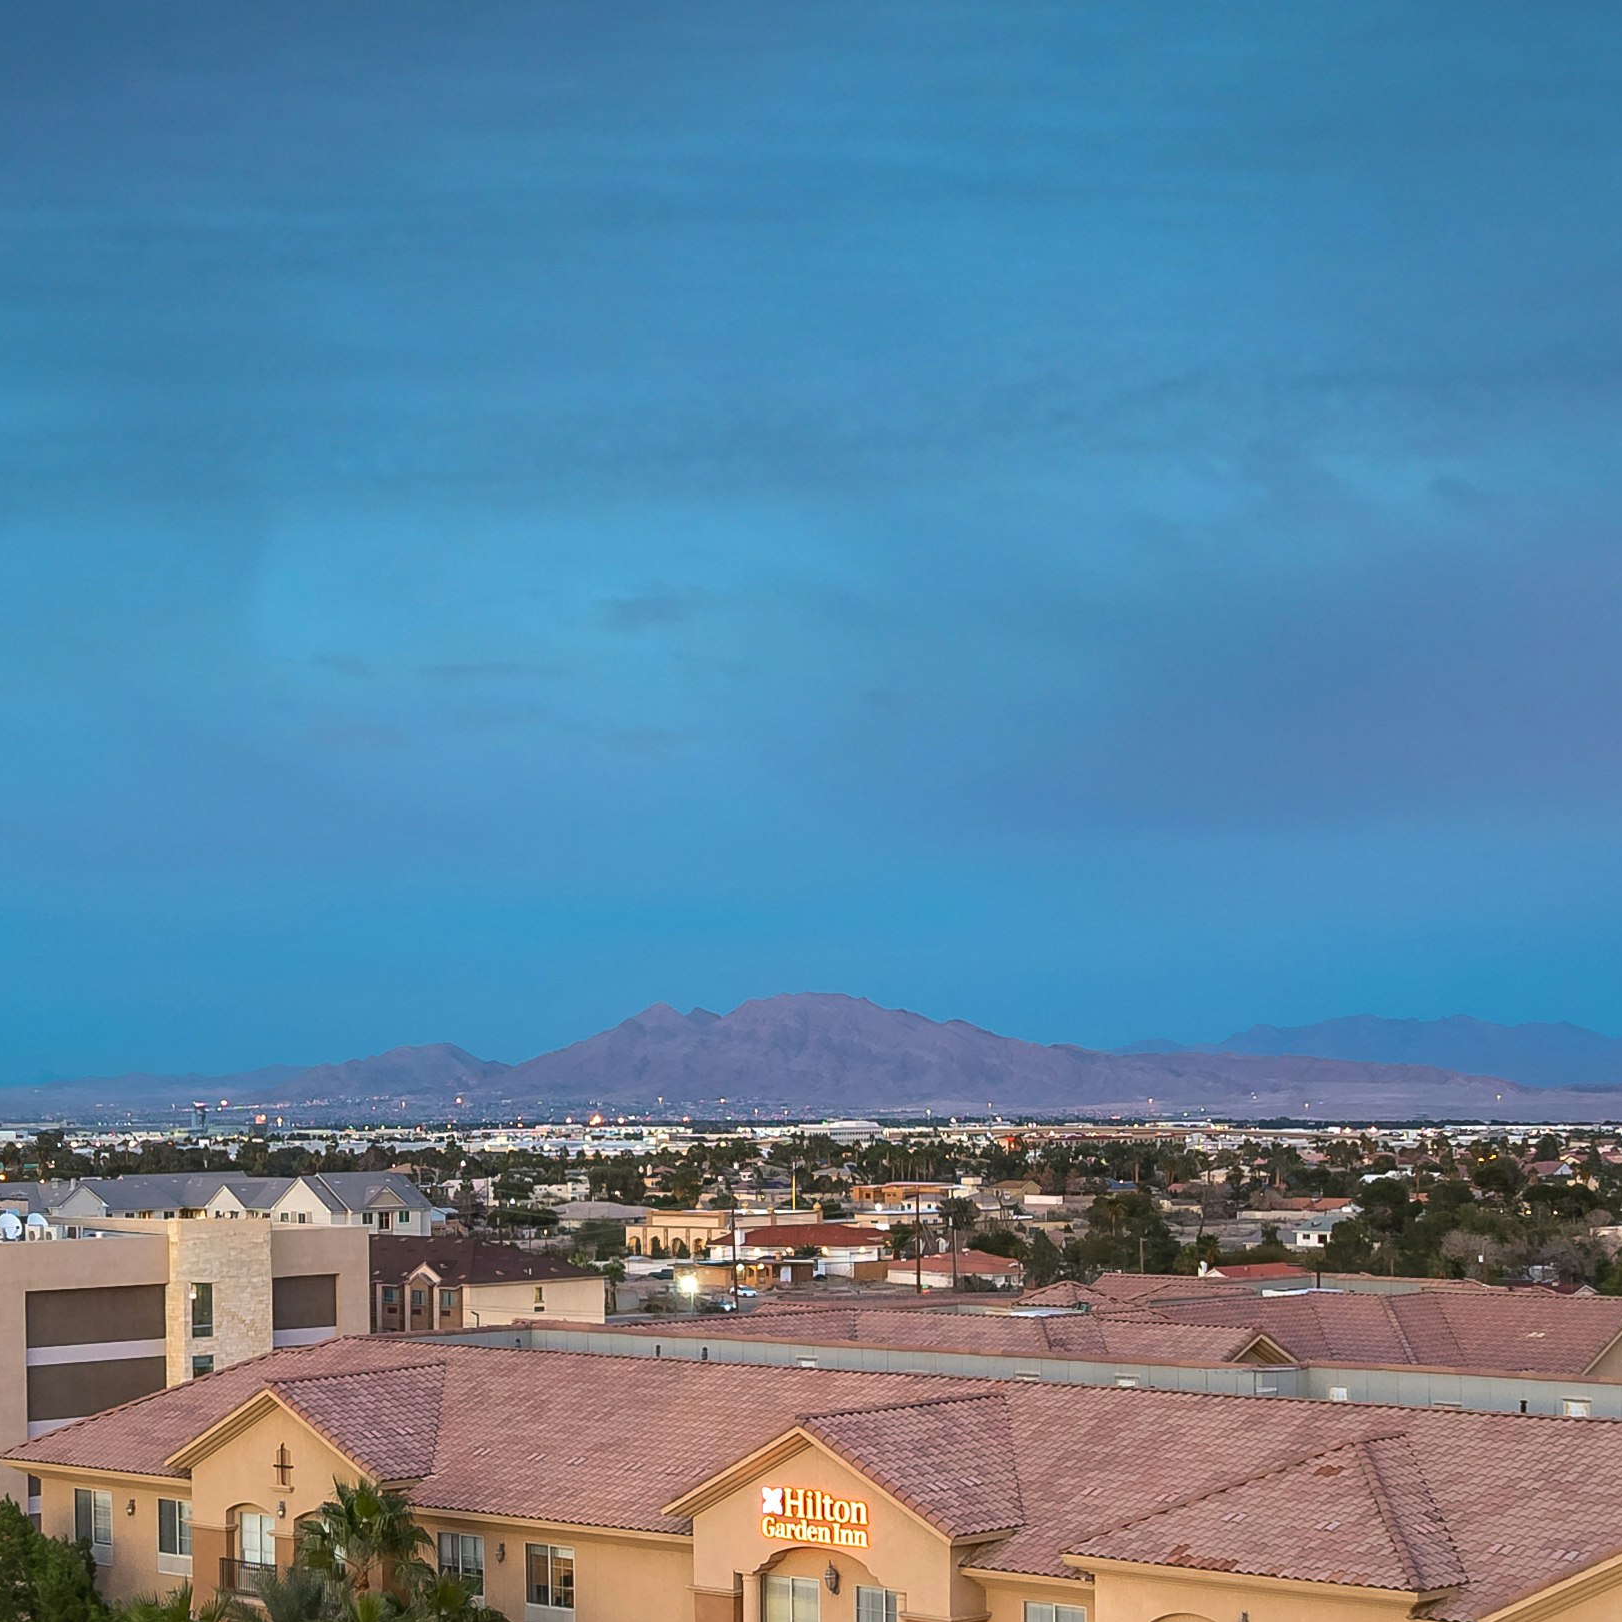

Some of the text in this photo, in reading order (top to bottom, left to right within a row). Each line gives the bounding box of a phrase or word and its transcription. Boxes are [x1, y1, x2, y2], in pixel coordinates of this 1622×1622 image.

[783, 1487, 868, 1525] Hilton
[761, 1517, 868, 1548] Garden Inn
